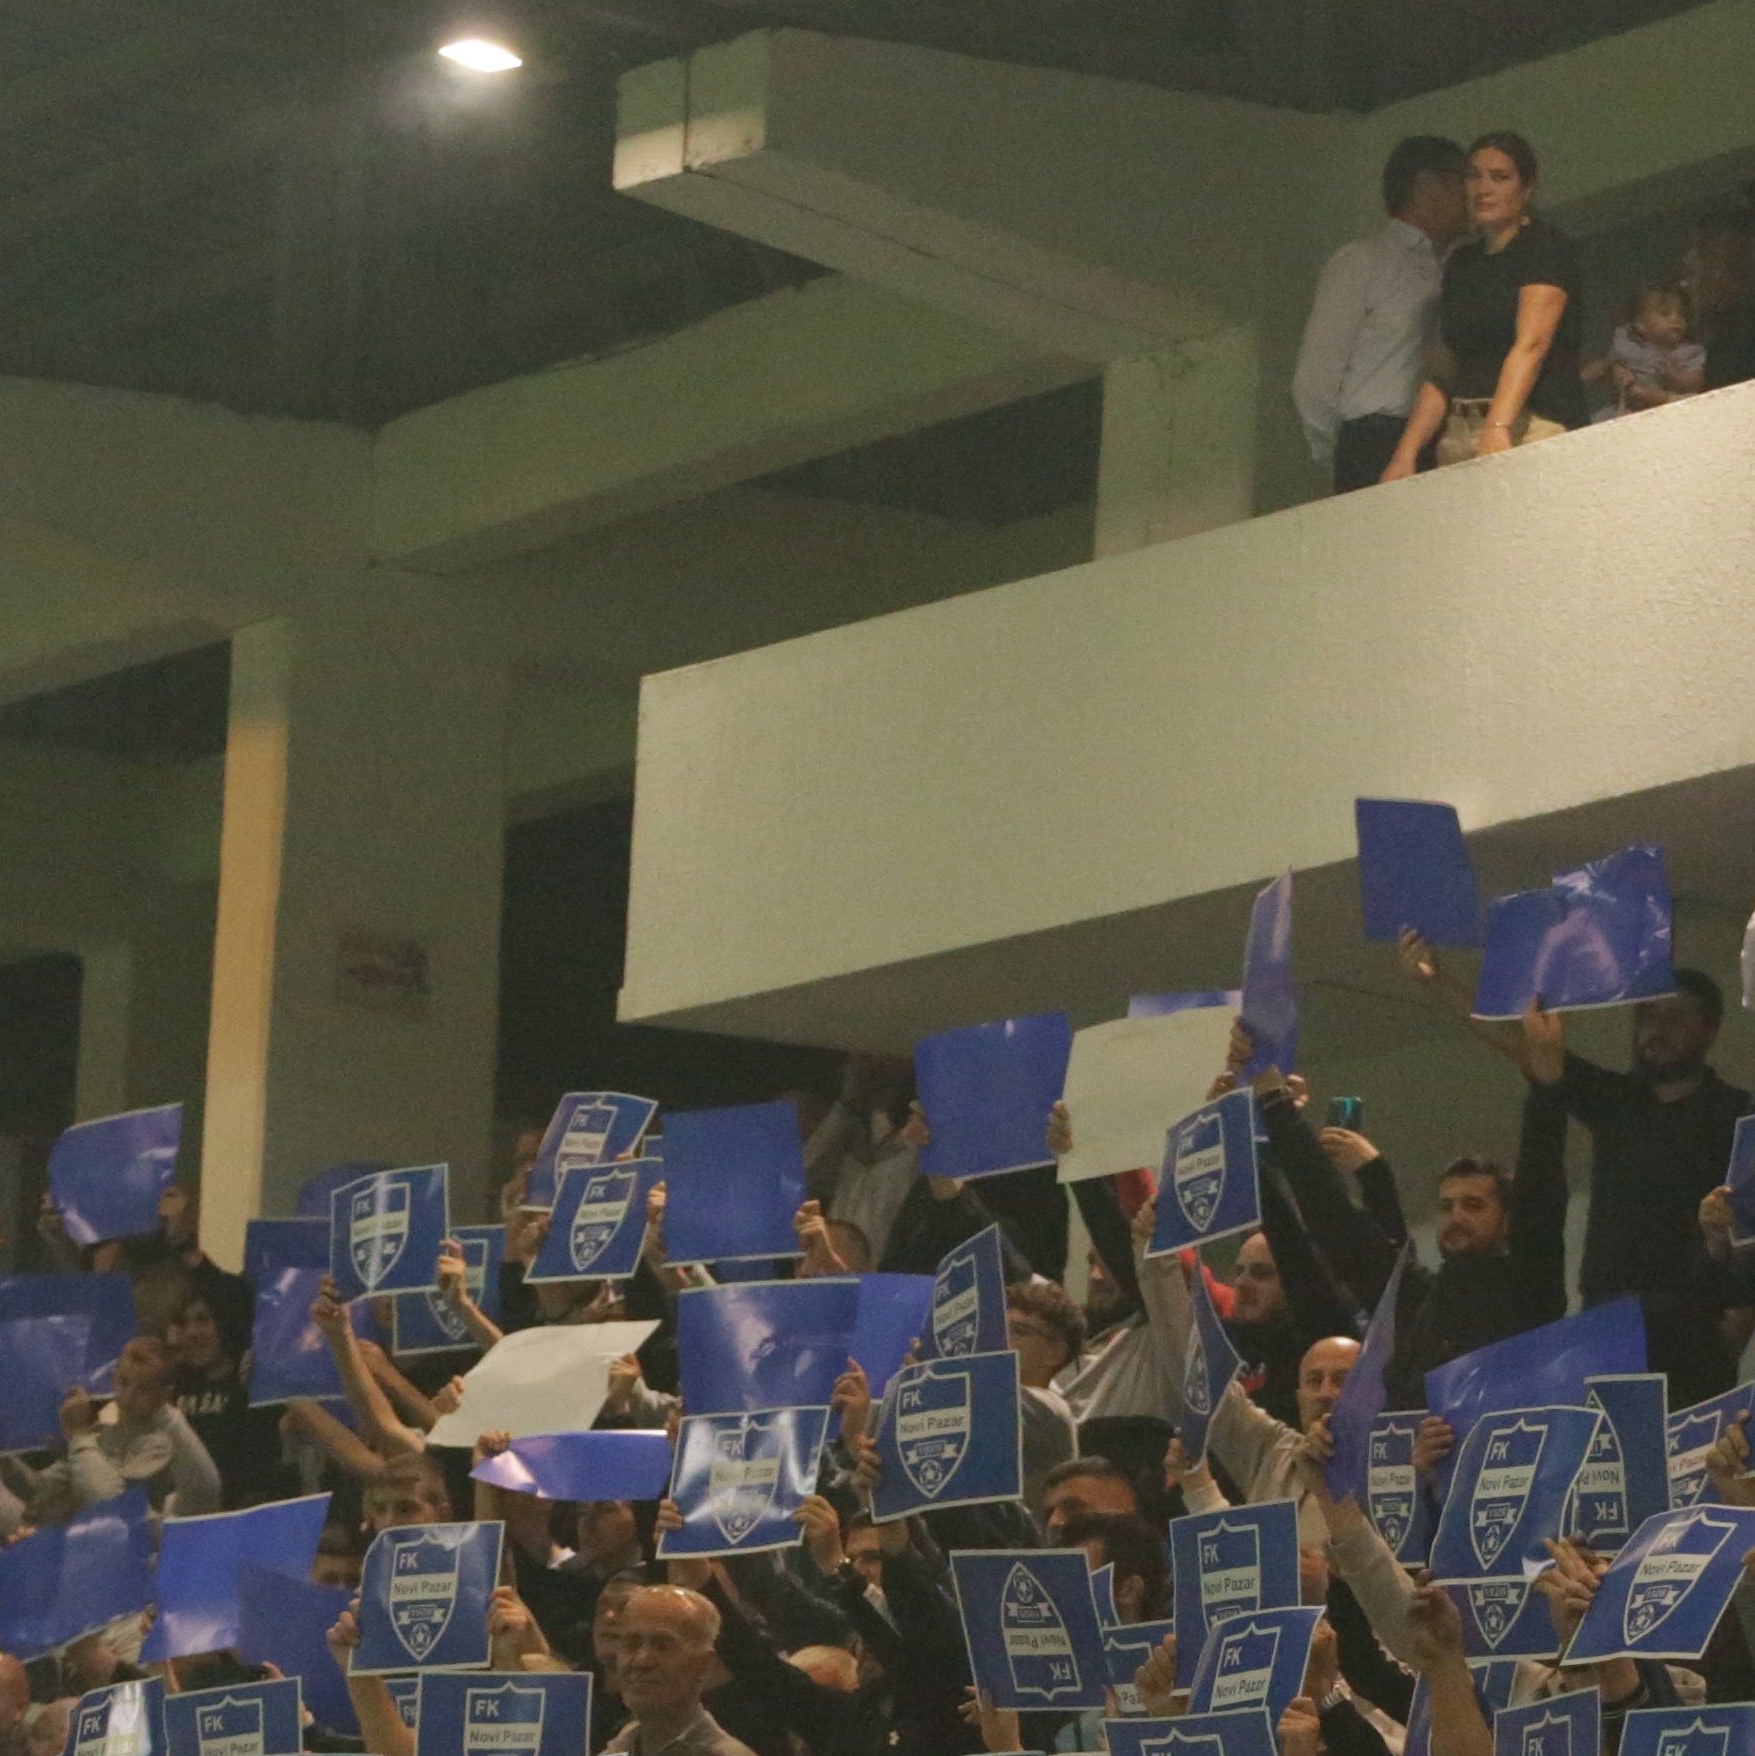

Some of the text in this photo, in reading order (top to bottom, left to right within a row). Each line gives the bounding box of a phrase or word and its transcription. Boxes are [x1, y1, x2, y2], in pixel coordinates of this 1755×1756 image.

[902, 1389, 921, 1407] FK
[899, 1412, 966, 1435] Novi Pazar
[1373, 1442, 1387, 1460] FK
[1490, 1441, 1509, 1460] FK
[1478, 1473, 1530, 1491] Novi Pazar
[1593, 1469, 1621, 1486] Novi
[1596, 1501, 1620, 1522] FK
[398, 1552, 419, 1569] FK
[1203, 1543, 1219, 1564] FK
[1640, 1559, 1701, 1577] Novi Pazar
[393, 1578, 452, 1595] Novi Pazar
[1224, 1576, 1256, 1593] Pazar
[1224, 1646, 1242, 1667] FK
[1050, 1662, 1072, 1681] FK
[1215, 1677, 1266, 1698] Novi Pazar
[476, 1699, 499, 1717] FK
[83, 1715, 101, 1735] FK
[204, 1715, 223, 1732] FK
[468, 1728, 535, 1744] Novi Pazar
[1528, 1737, 1543, 1756] FK
